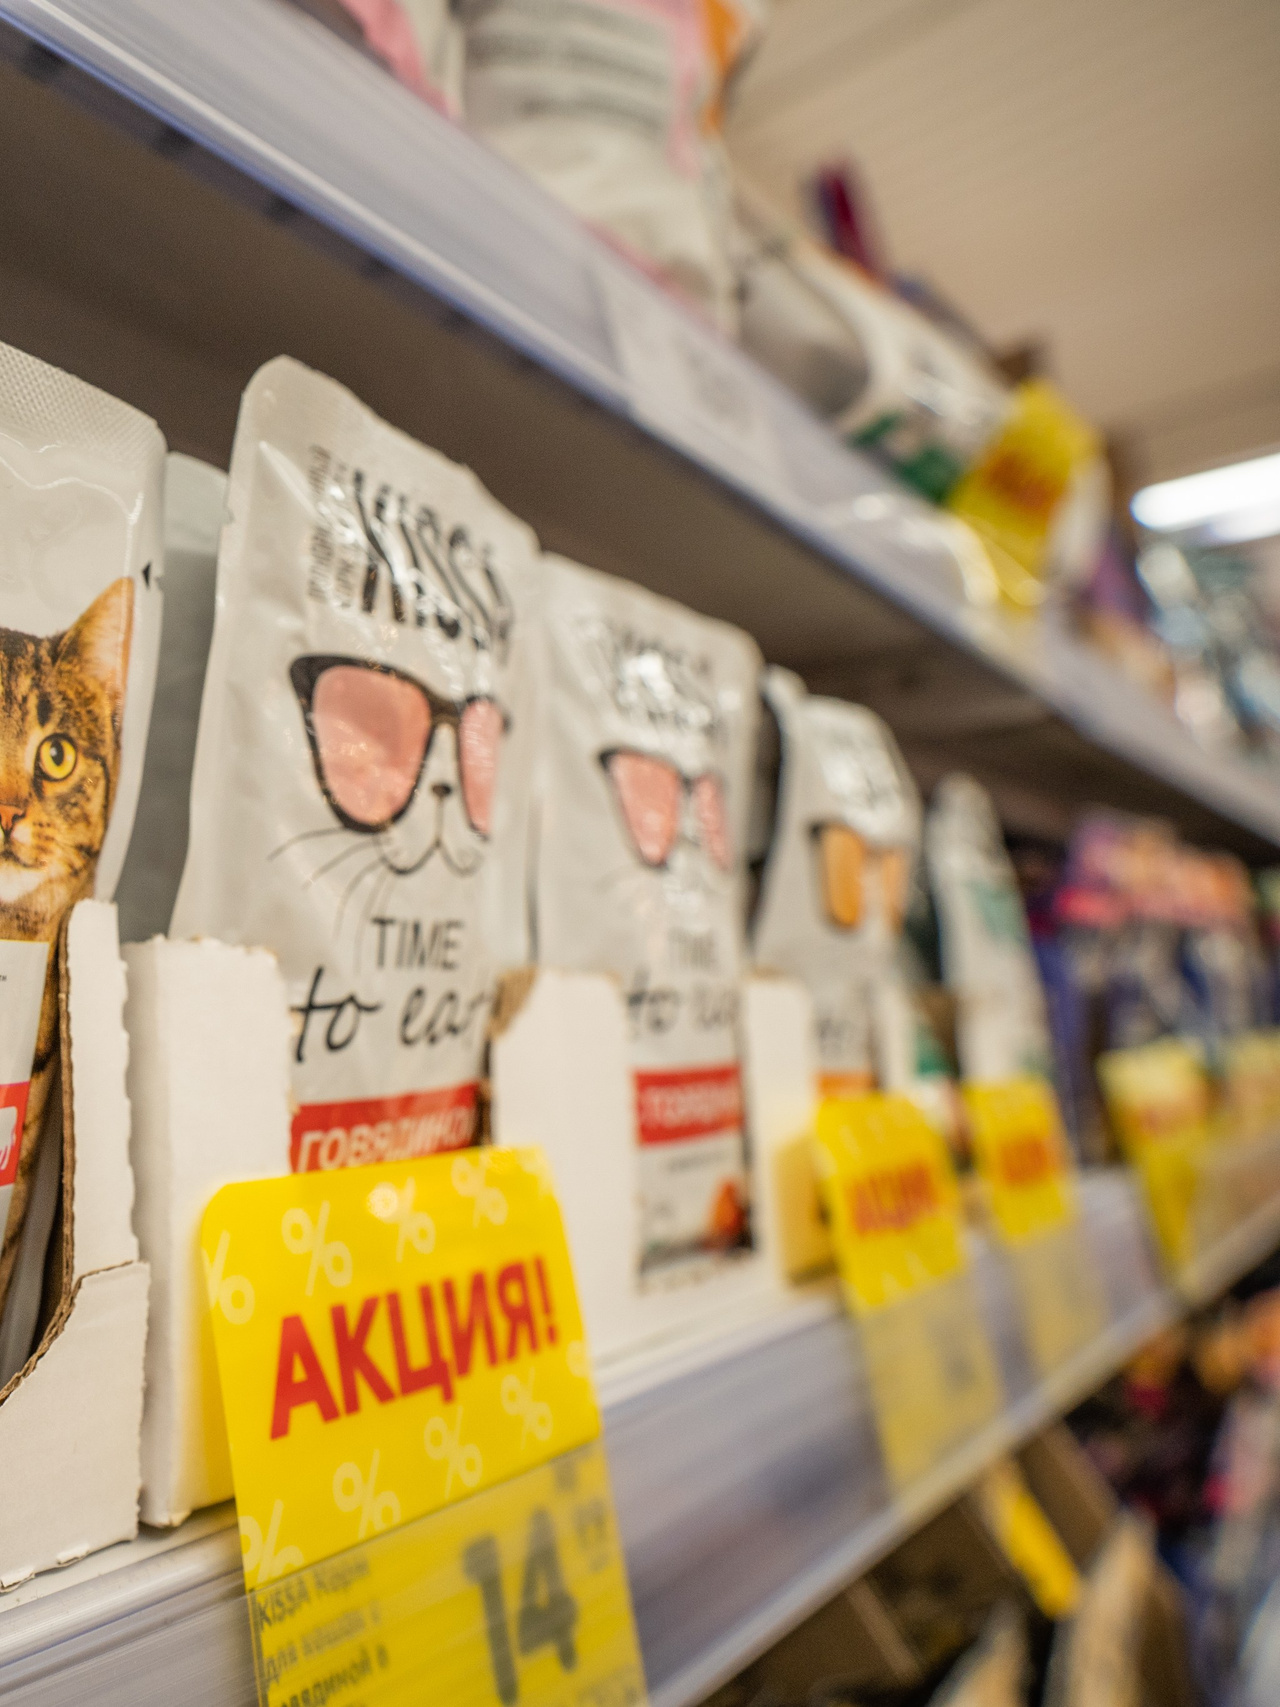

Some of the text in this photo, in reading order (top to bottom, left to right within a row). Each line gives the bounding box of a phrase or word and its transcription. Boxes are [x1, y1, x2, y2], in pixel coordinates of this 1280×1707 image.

[289, 964, 382, 1063] to
[371, 915, 464, 970] TIME
[270, 1254, 561, 1442] АКЦИЯ!
[461, 1505, 579, 1707] 14
